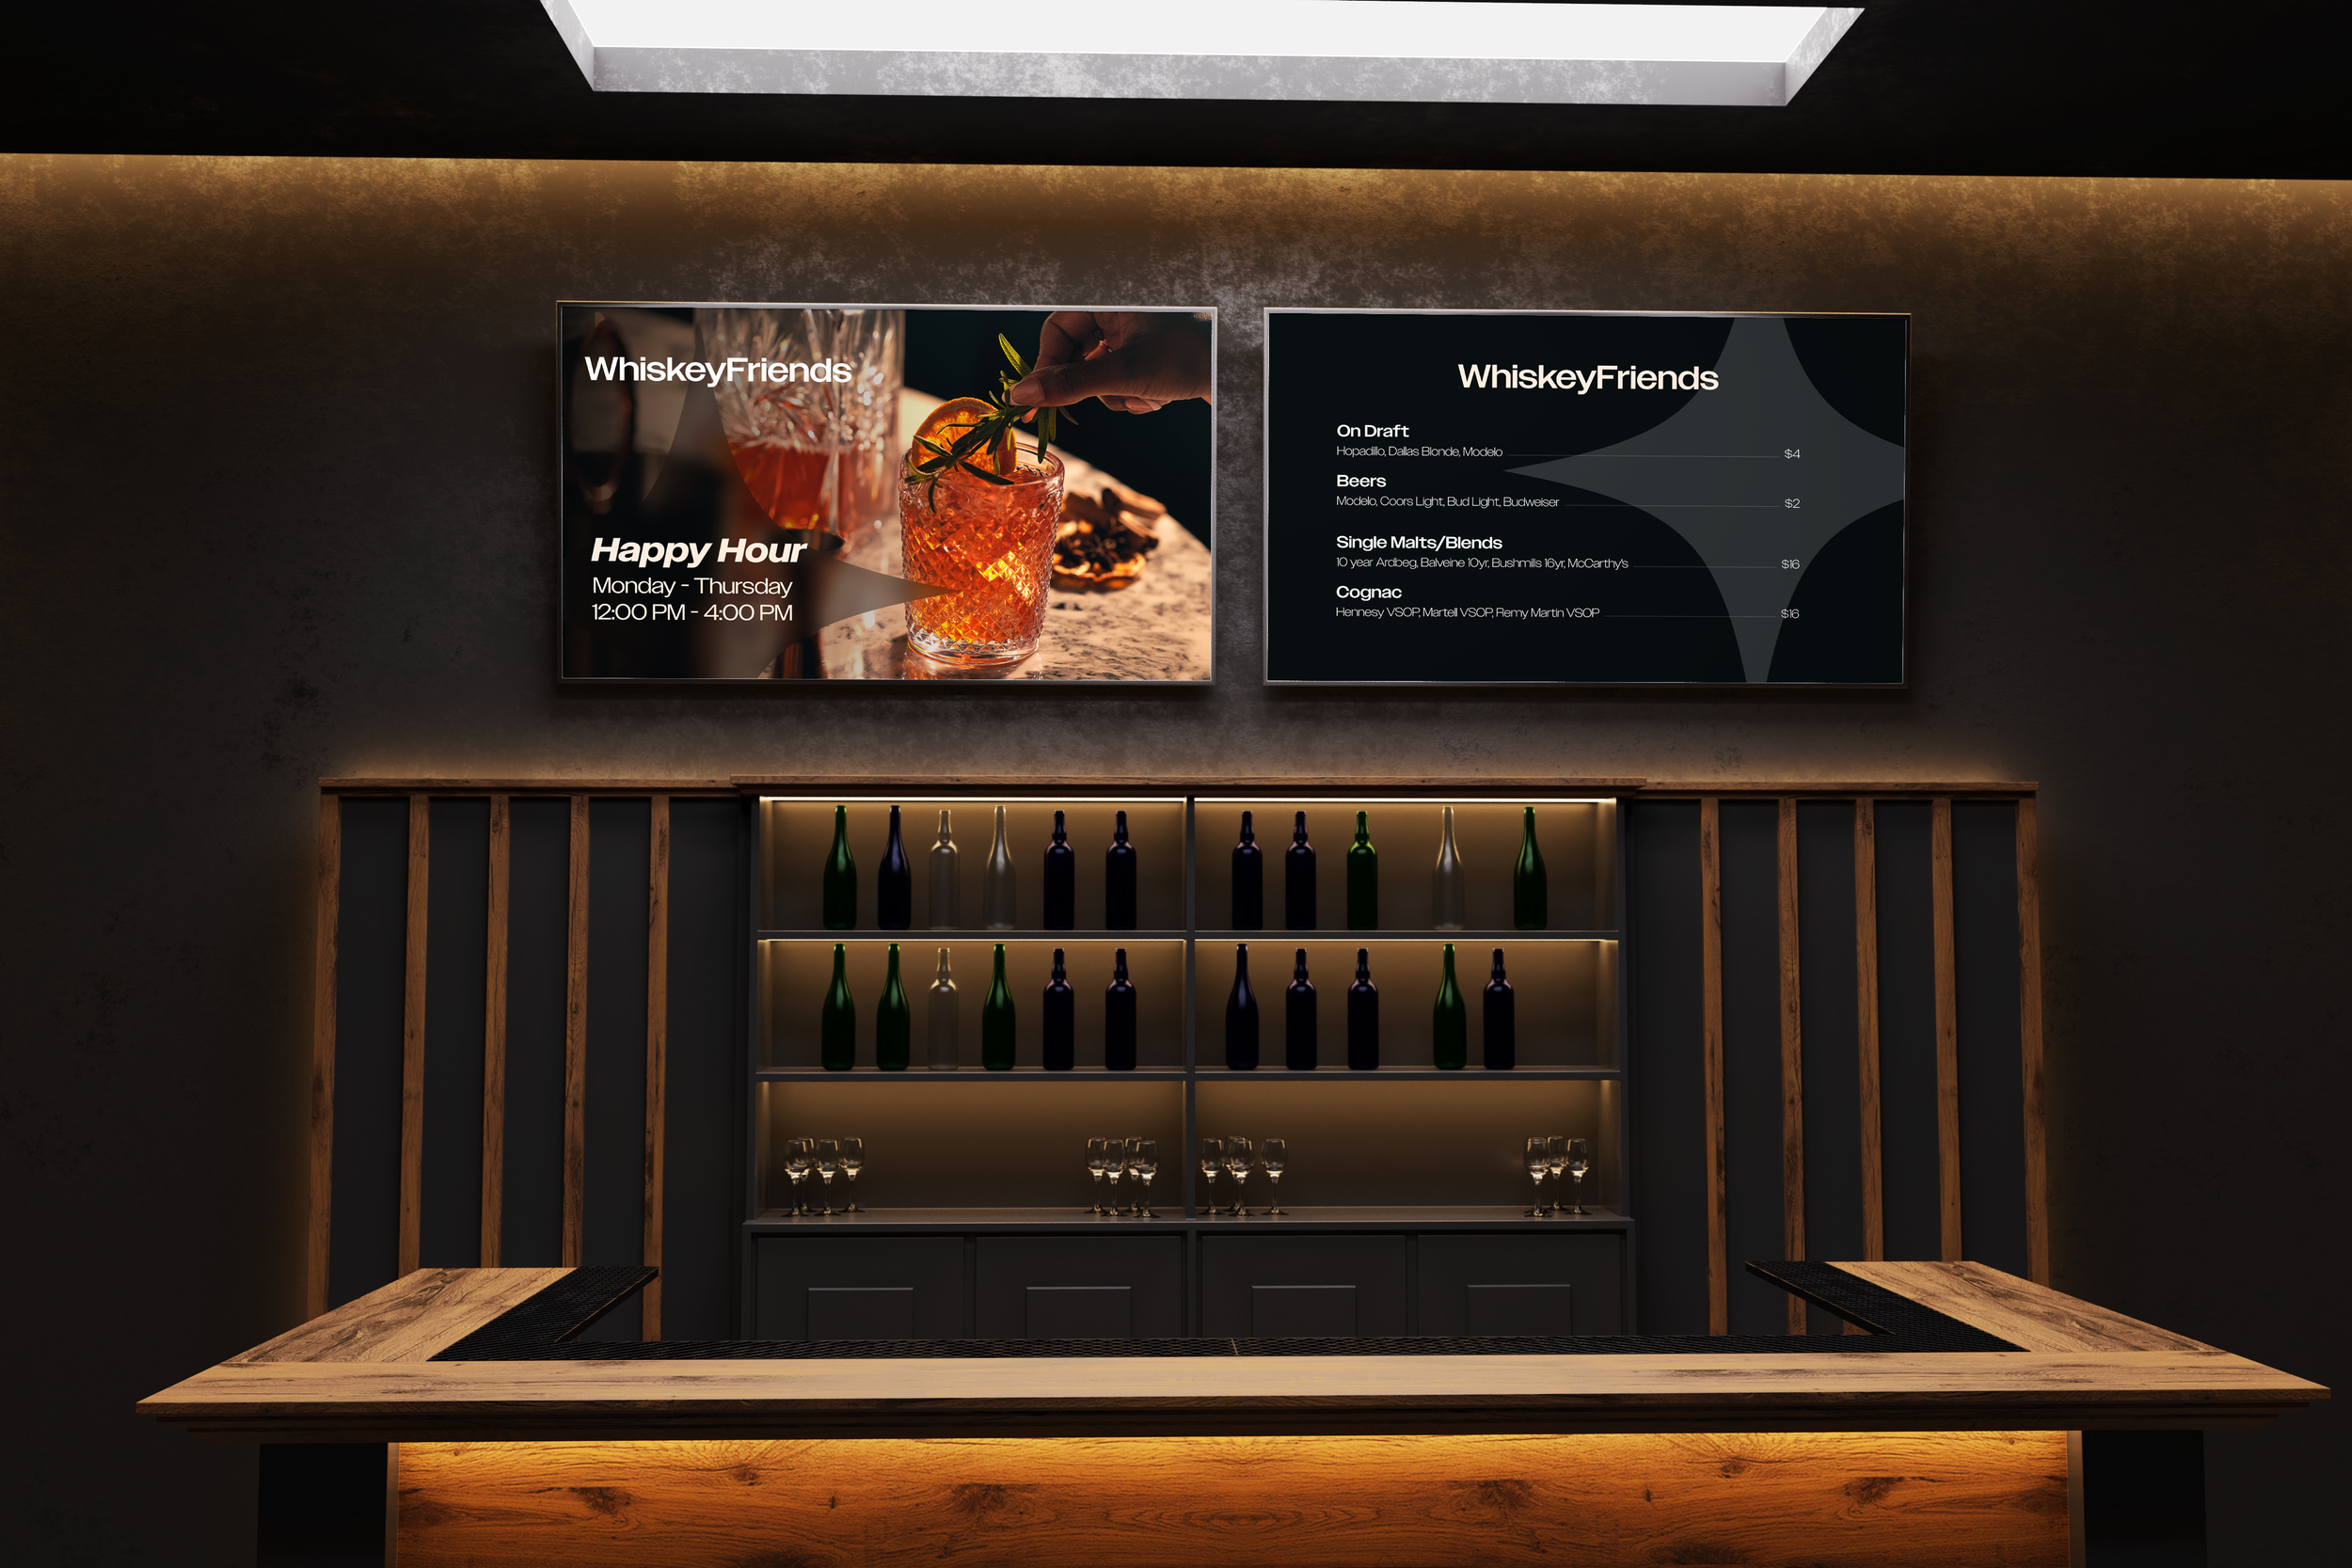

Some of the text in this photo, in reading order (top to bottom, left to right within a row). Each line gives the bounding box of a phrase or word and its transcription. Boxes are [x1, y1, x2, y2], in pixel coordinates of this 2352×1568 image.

[584, 356, 852, 388] WhiskeyFriends
[1458, 363, 1720, 395] WhiskeyFriends
[1336, 423, 1410, 438] On Draft
[1336, 445, 1801, 459] Hopadillo, Dallas Blonde, Modelo $4
[1336, 474, 1387, 488] Beers
[1336, 495, 1801, 509] Modelo, Coors Light, Bud Light, Budweiser $2
[1336, 534, 1503, 552] Single Malts/Blends
[591, 537, 809, 568] Happy Hour
[1336, 556, 1348, 567] 10
[1349, 558, 1374, 570] year
[1375, 557, 1419, 570] Ardbeg,
[1420, 557, 1466, 568] Balveine
[1467, 557, 1490, 570] 10yr,
[1491, 557, 1543, 569] Bushmills
[1544, 557, 1566, 571] 16yr,
[1781, 559, 1801, 570] $16
[593, 577, 676, 598] Monday
[693, 577, 793, 599] Thursday
[1335, 585, 1403, 602] Cognac
[592, 603, 647, 621] 12:00
[652, 603, 686, 621] PM
[703, 604, 755, 622] 4:00
[759, 604, 793, 622] PM
[1335, 606, 1800, 621] Hennesy VSOP, Martell VSOP, Remy Martin VSOP $16
